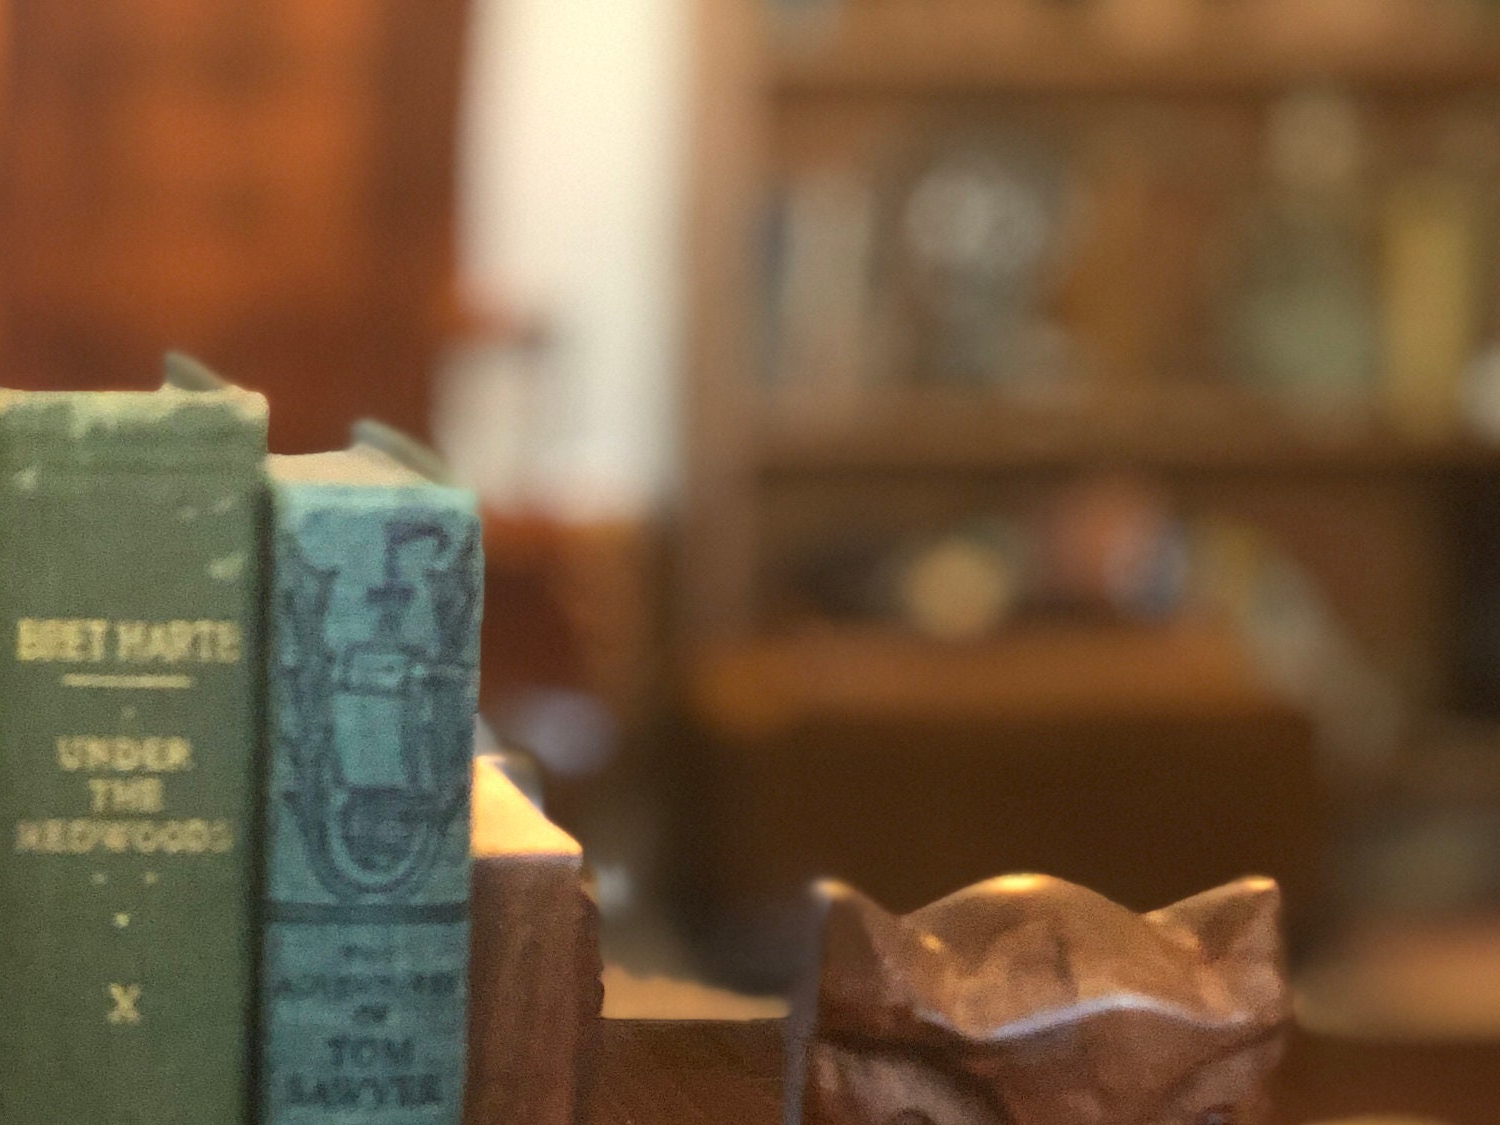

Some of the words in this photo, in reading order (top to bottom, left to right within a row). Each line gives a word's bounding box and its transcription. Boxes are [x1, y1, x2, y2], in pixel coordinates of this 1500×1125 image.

[16, 617, 107, 662] BRET
[115, 618, 242, 663] HARTE
[56, 735, 192, 772] UNDER
[88, 777, 164, 813] THE
[14, 818, 237, 855] REDWOODS
[107, 982, 142, 1026] X
[327, 1036, 414, 1067] TOM
